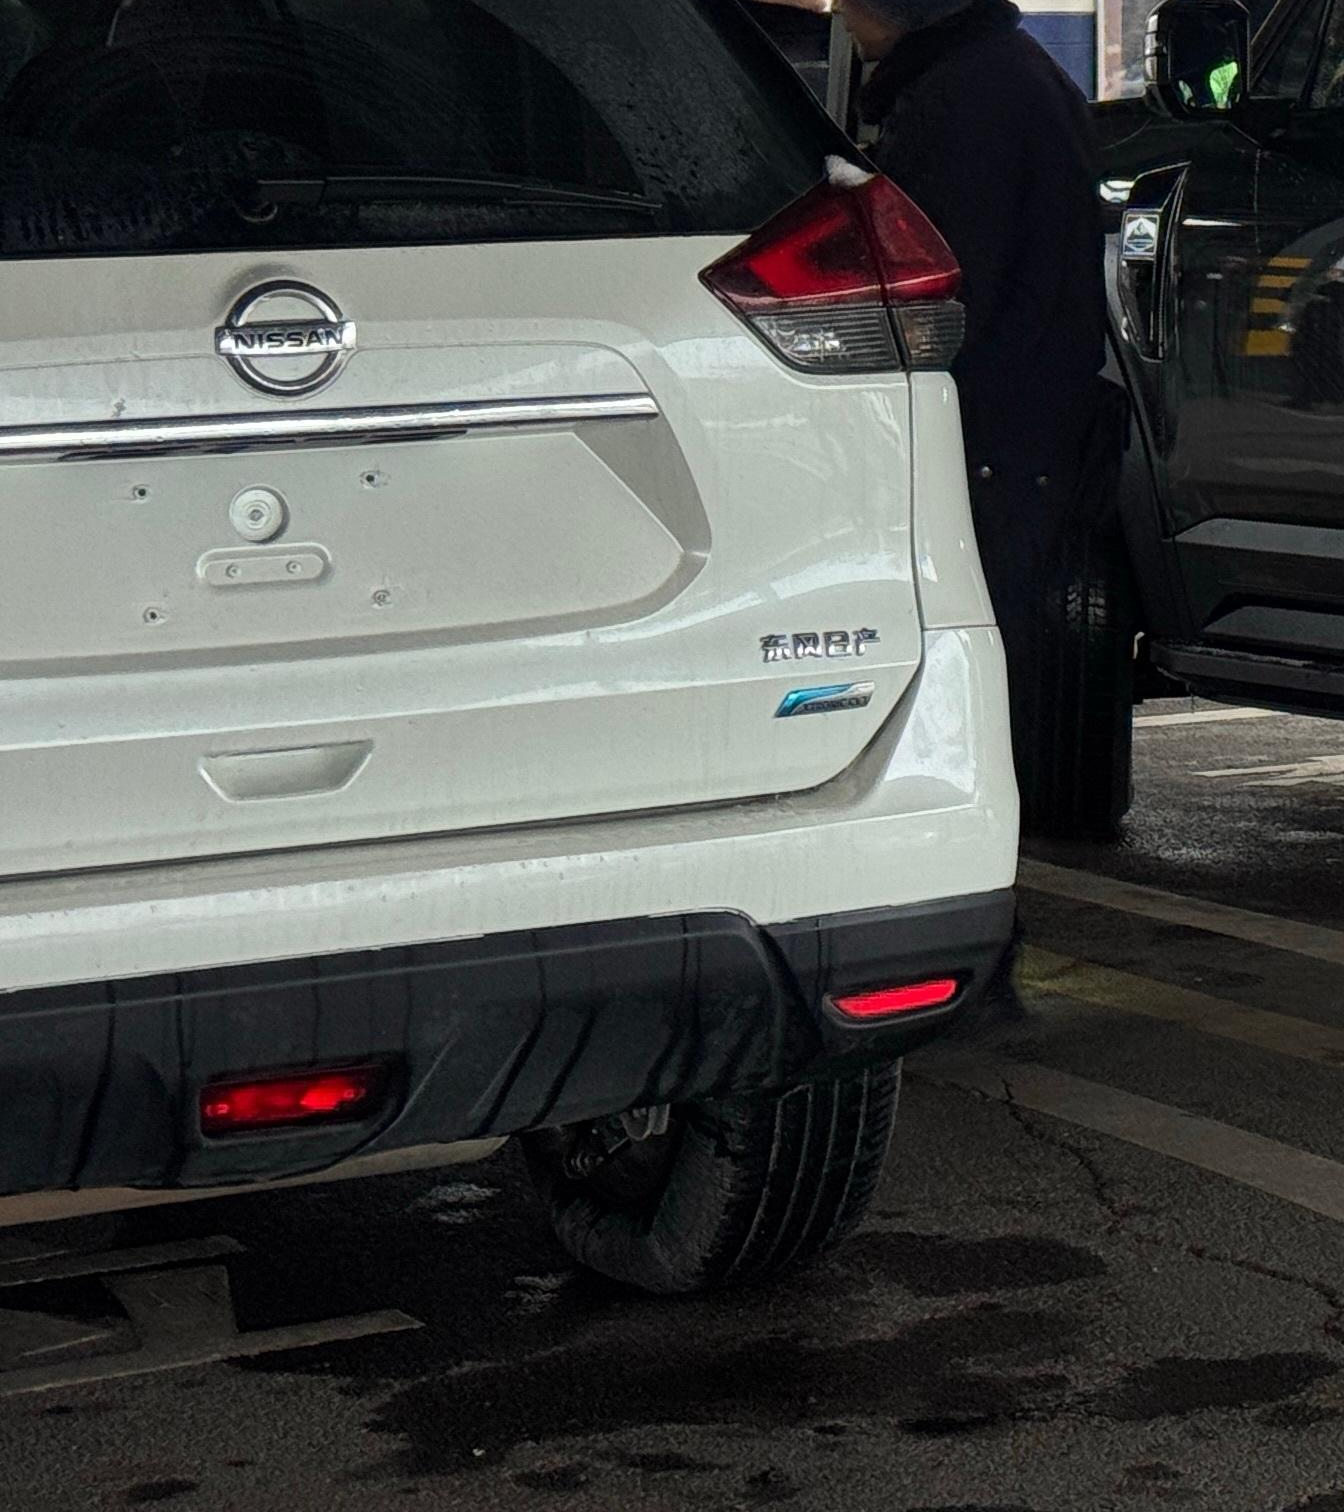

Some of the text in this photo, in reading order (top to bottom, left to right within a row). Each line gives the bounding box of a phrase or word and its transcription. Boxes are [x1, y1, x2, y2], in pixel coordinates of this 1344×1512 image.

[233, 329, 344, 349] NISSAN
[760, 627, 881, 663] 东风日产
